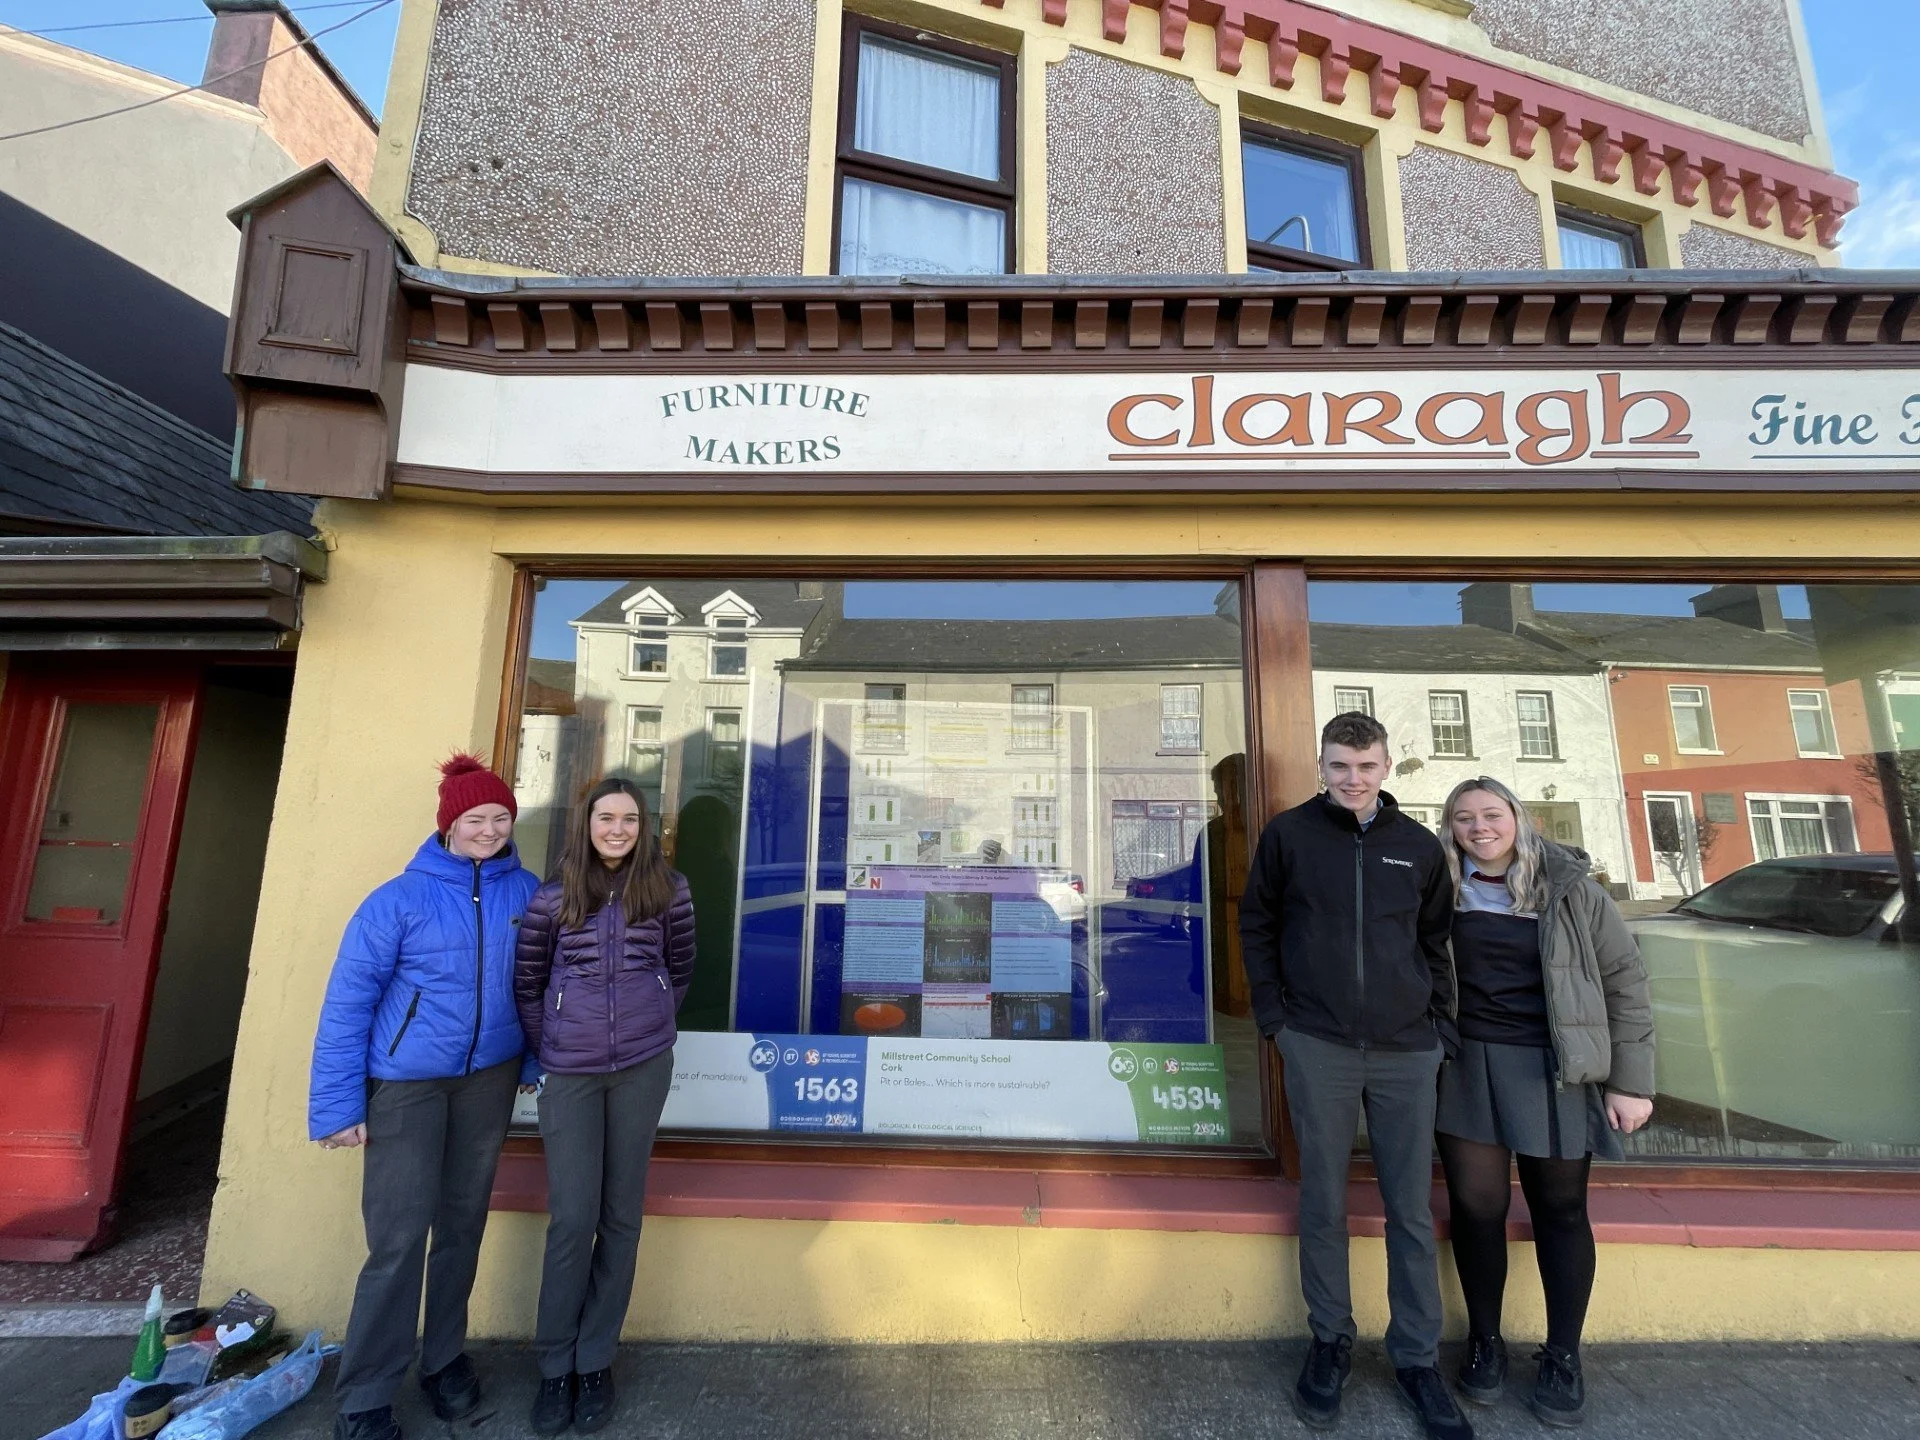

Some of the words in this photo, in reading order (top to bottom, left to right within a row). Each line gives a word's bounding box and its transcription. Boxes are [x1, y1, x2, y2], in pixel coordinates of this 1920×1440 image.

[659, 383, 870, 419] FURNITURE
[1749, 394, 1878, 446] Fine
[684, 434, 842, 466] MAKERS
[870, 877, 881, 889] N
[881, 1051, 924, 1062] Millstreet
[926, 1053, 979, 1065] Community
[980, 1054, 1011, 1064] School
[881, 1063, 903, 1072] Cork
[691, 1071, 700, 1080] of
[880, 1077, 891, 1086] Pit
[893, 1078, 903, 1086] or
[936, 1078, 963, 1088] Which
[965, 1079, 972, 1088] is
[974, 1081, 996, 1089] more
[998, 1079, 1051, 1091] sustainable?
[794, 1077, 858, 1102] 1563
[1153, 1086, 1222, 1110] 4534
